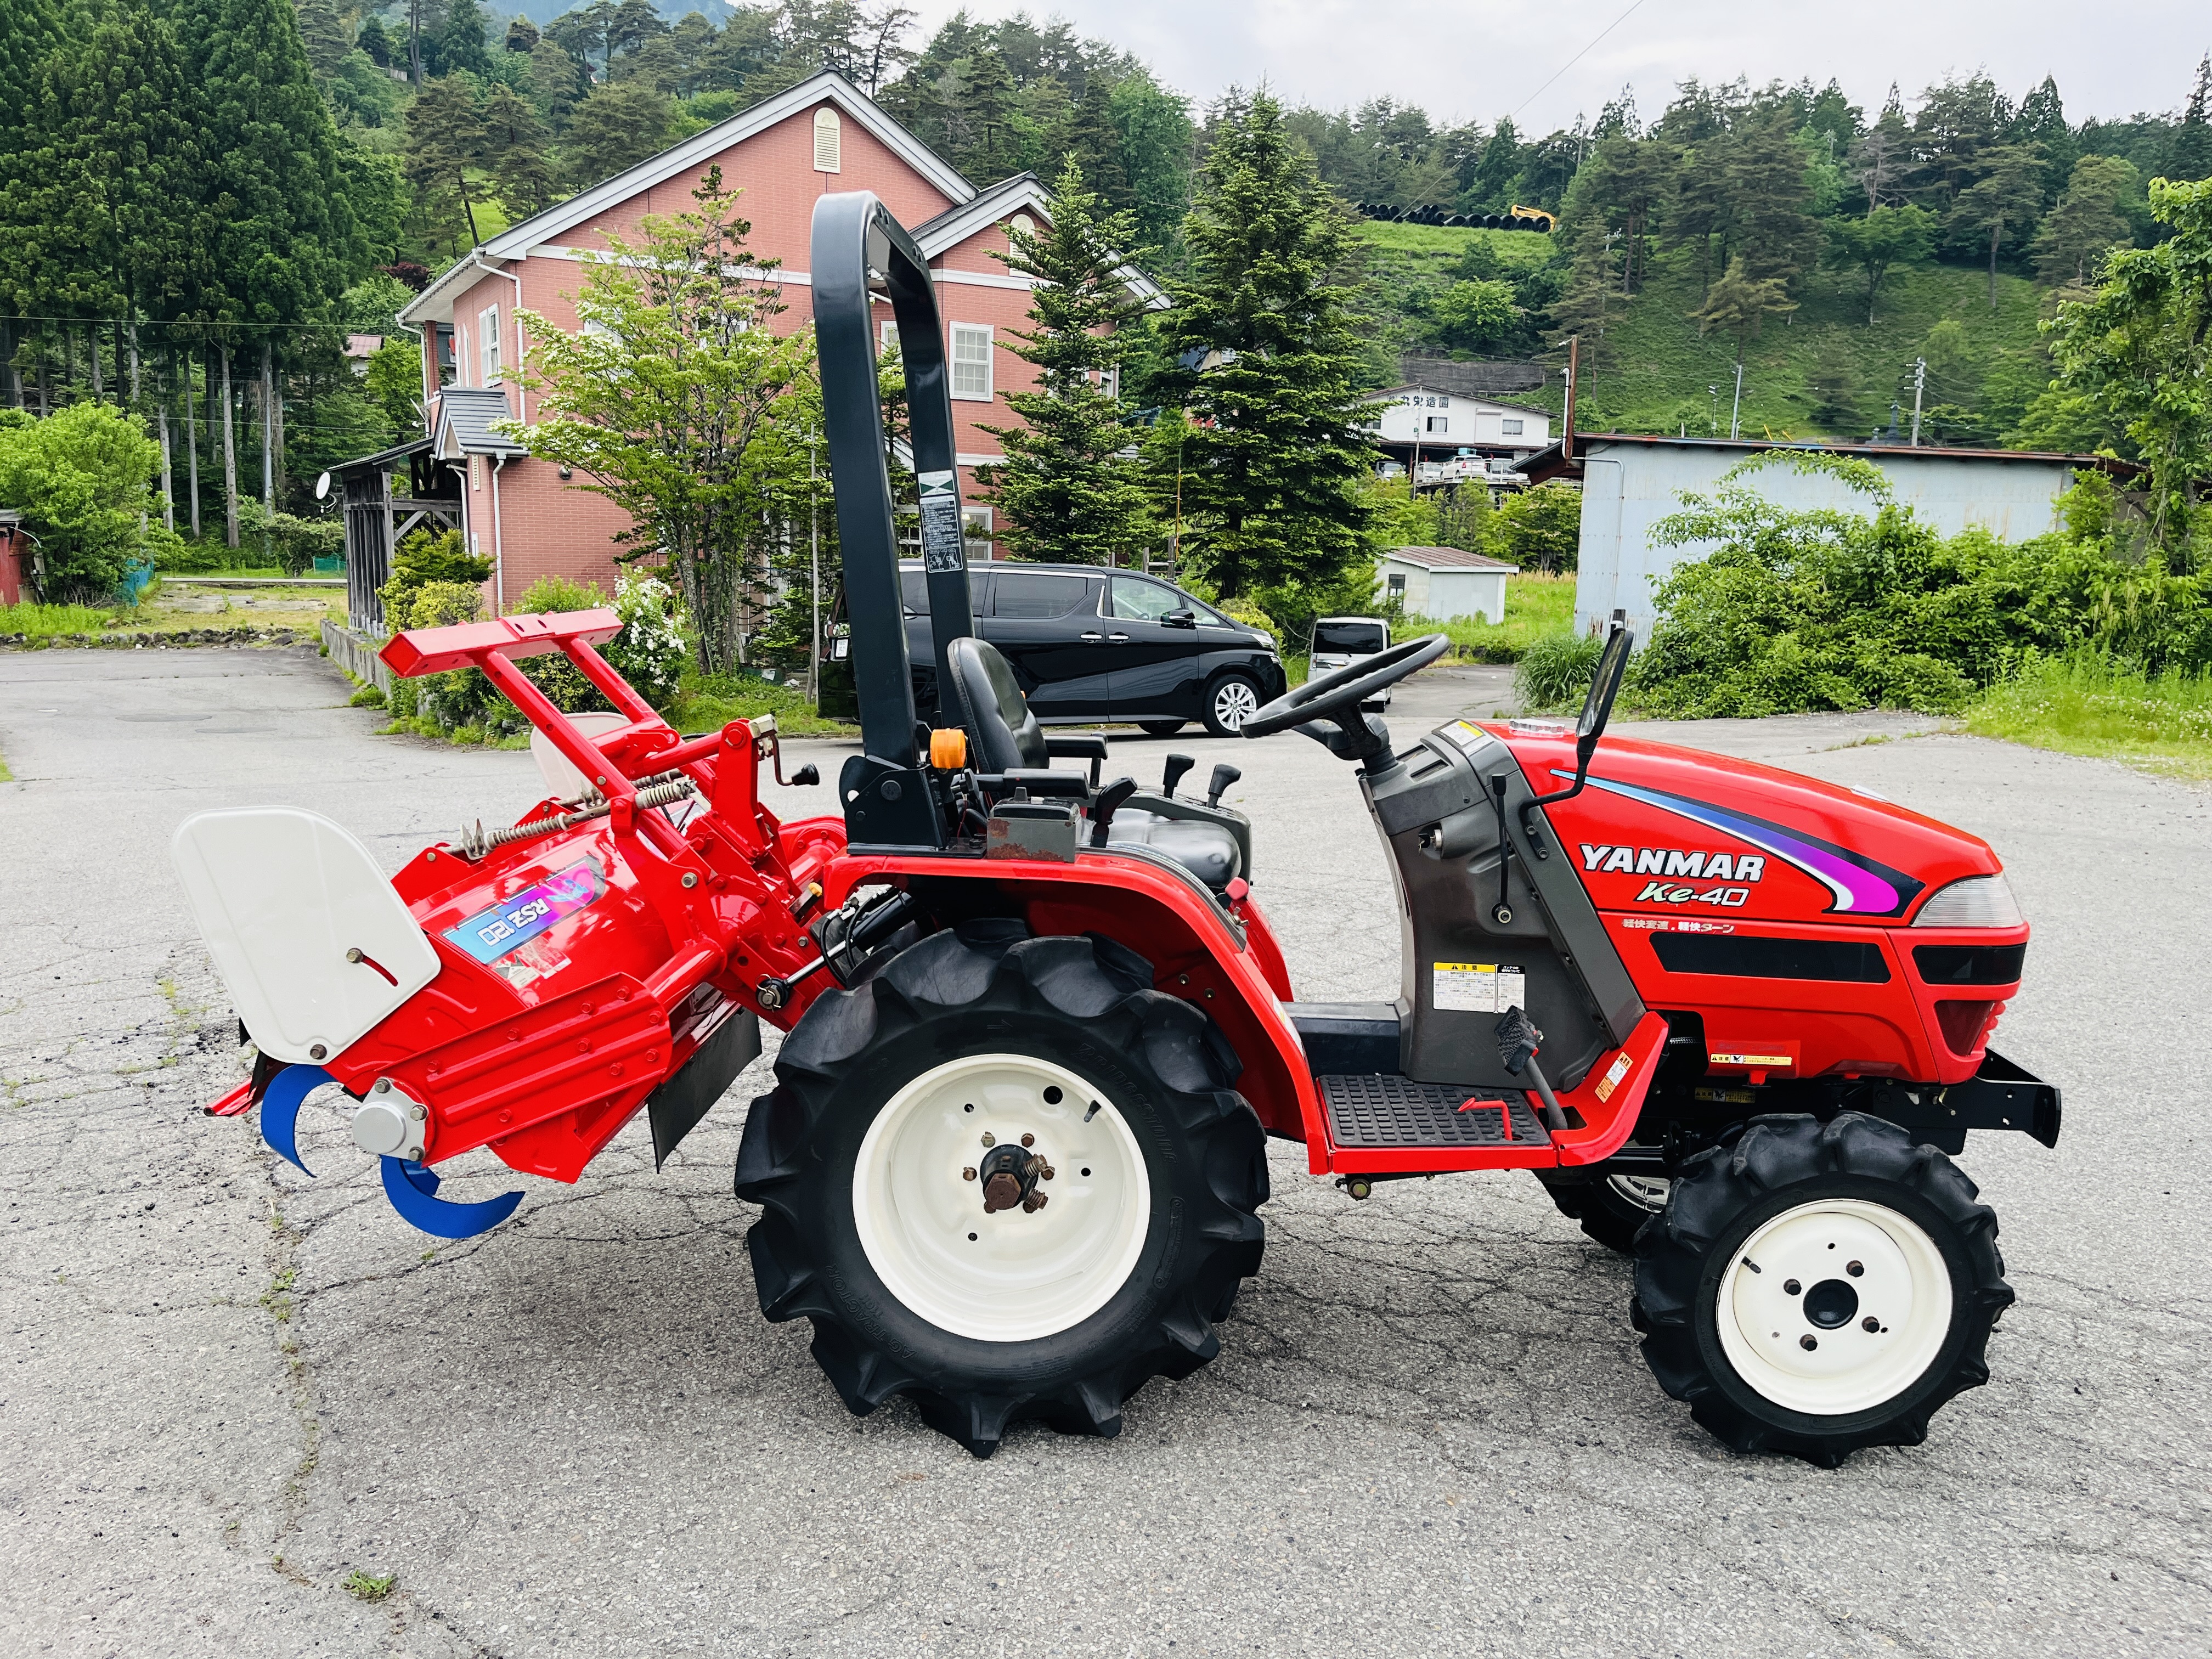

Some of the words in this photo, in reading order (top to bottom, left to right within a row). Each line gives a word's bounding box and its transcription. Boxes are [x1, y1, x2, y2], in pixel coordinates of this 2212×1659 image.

[1579, 844, 1766, 882] YANMAR
[1634, 881, 1750, 907] Ke-40
[506, 897, 551, 928] RSZ
[476, 919, 515, 946] 120
[825, 1263, 887, 1342] TRACTOR
[887, 1338, 917, 1359] AG
